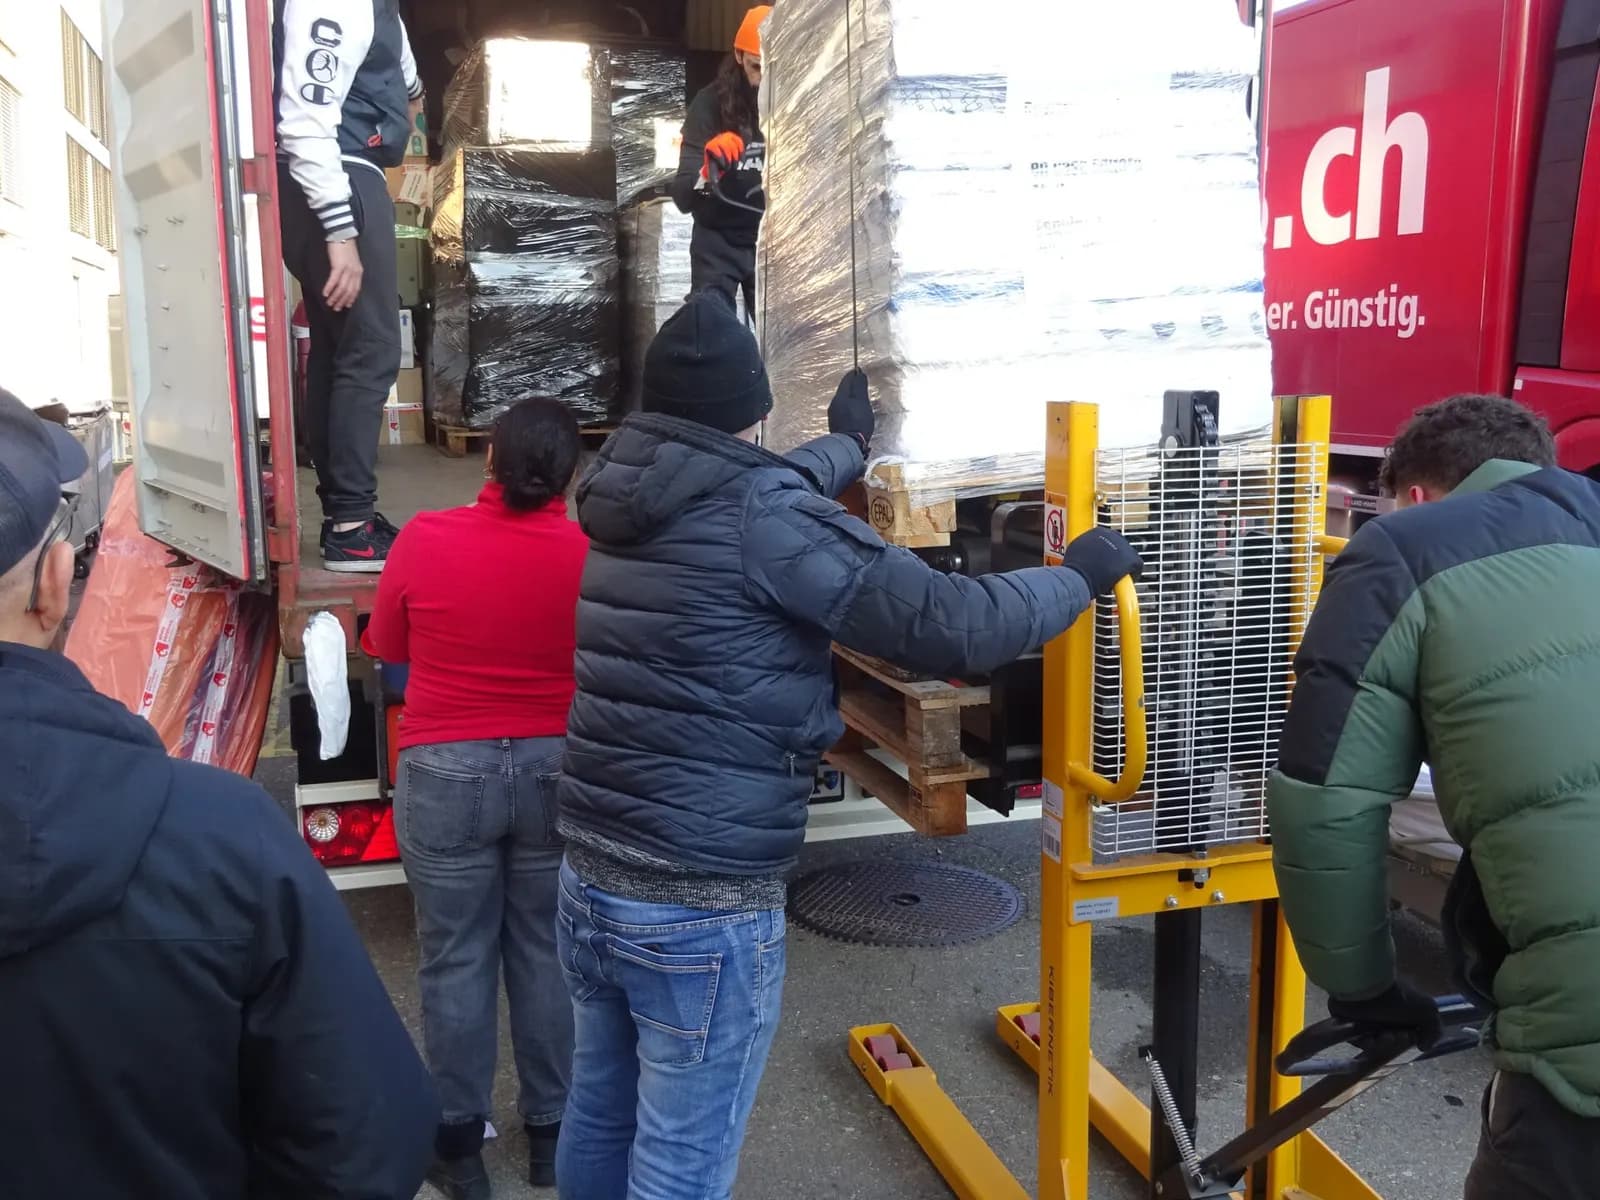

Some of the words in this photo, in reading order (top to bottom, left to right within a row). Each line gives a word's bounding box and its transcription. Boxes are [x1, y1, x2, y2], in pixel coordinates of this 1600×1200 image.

[1262, 66, 1429, 250] .ch
[1266, 301, 1297, 330] er.
[1304, 283, 1425, 339] Günstig.
[1047, 965, 1055, 1097] KIBERNETIK
